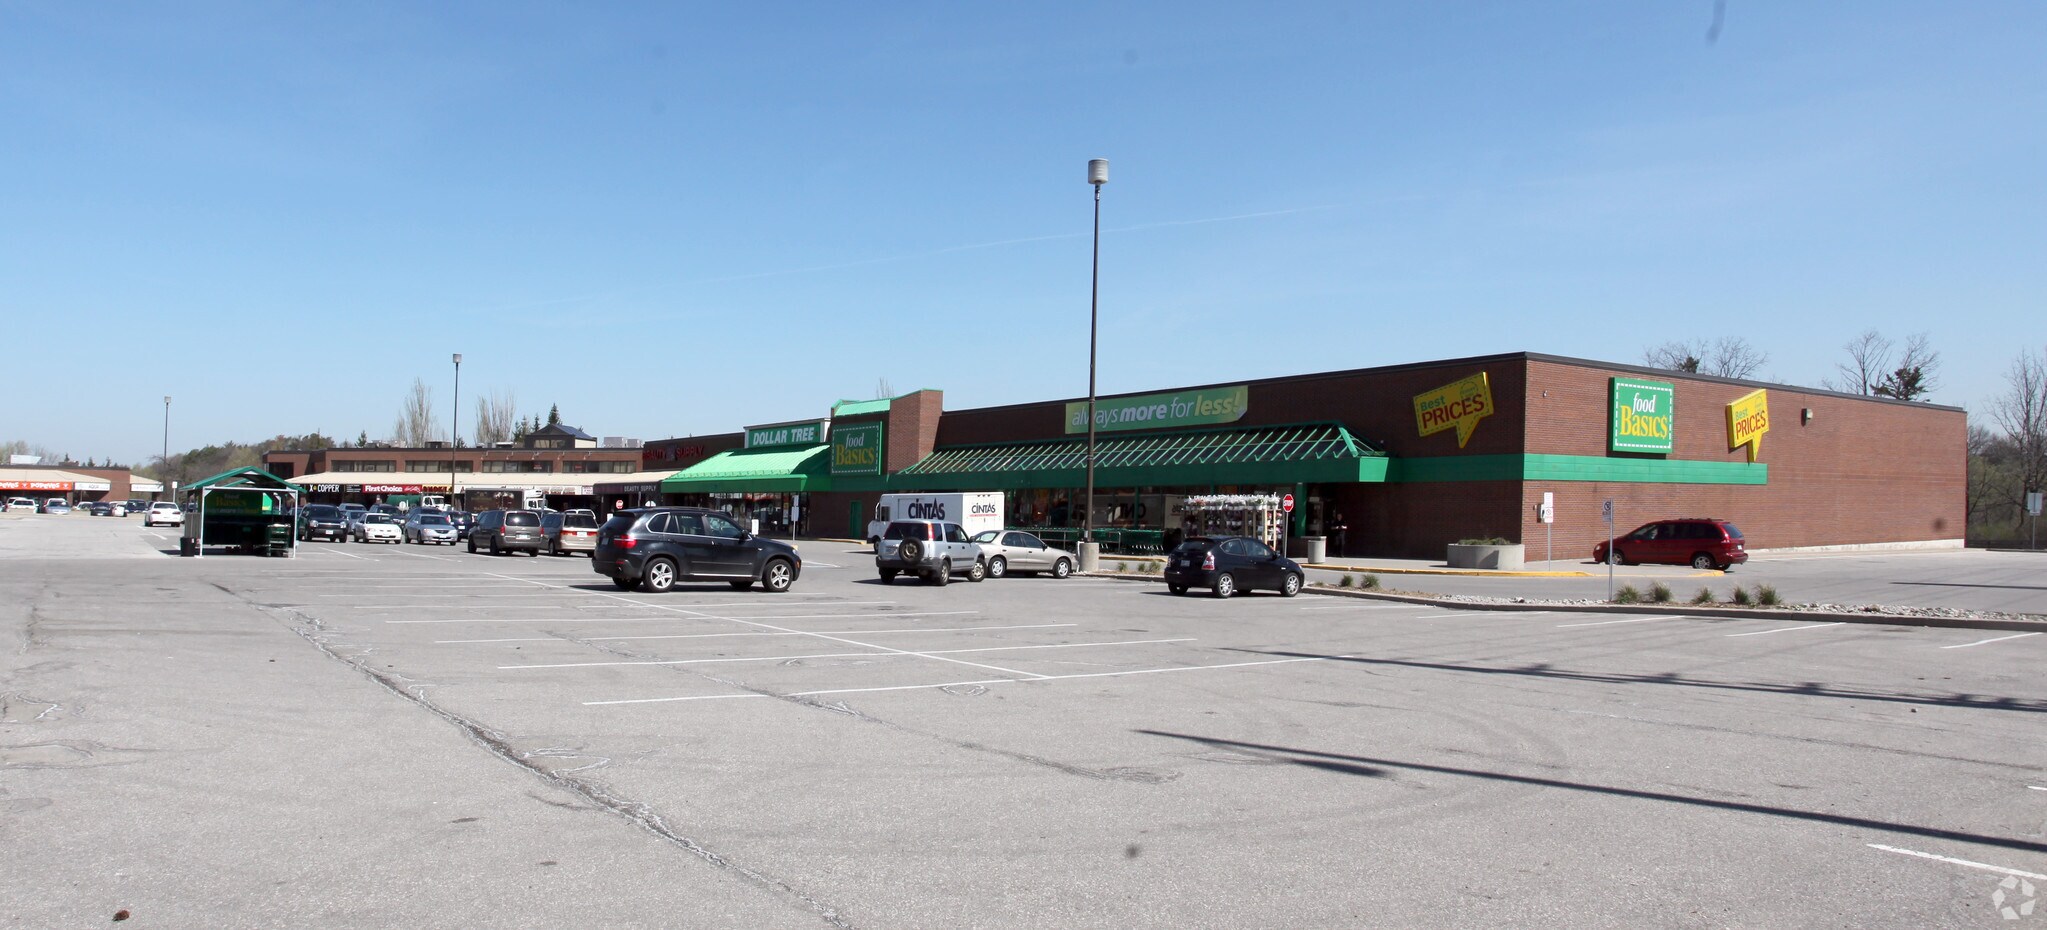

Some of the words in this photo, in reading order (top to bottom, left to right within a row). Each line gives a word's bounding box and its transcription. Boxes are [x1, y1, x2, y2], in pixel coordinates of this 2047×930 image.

[1120, 404, 1167, 422] more
[1170, 397, 1194, 418] for
[1194, 392, 1242, 417] less!
[1421, 395, 1446, 411] Best
[1422, 394, 1485, 429] PRICES
[1632, 392, 1656, 415] food
[1735, 410, 1766, 440] PRICES
[752, 430, 787, 445] DOLLAR
[791, 427, 815, 442] TREE
[845, 432, 865, 450] food
[676, 445, 705, 458] SUPPLY
[317, 484, 340, 492] COPPER
